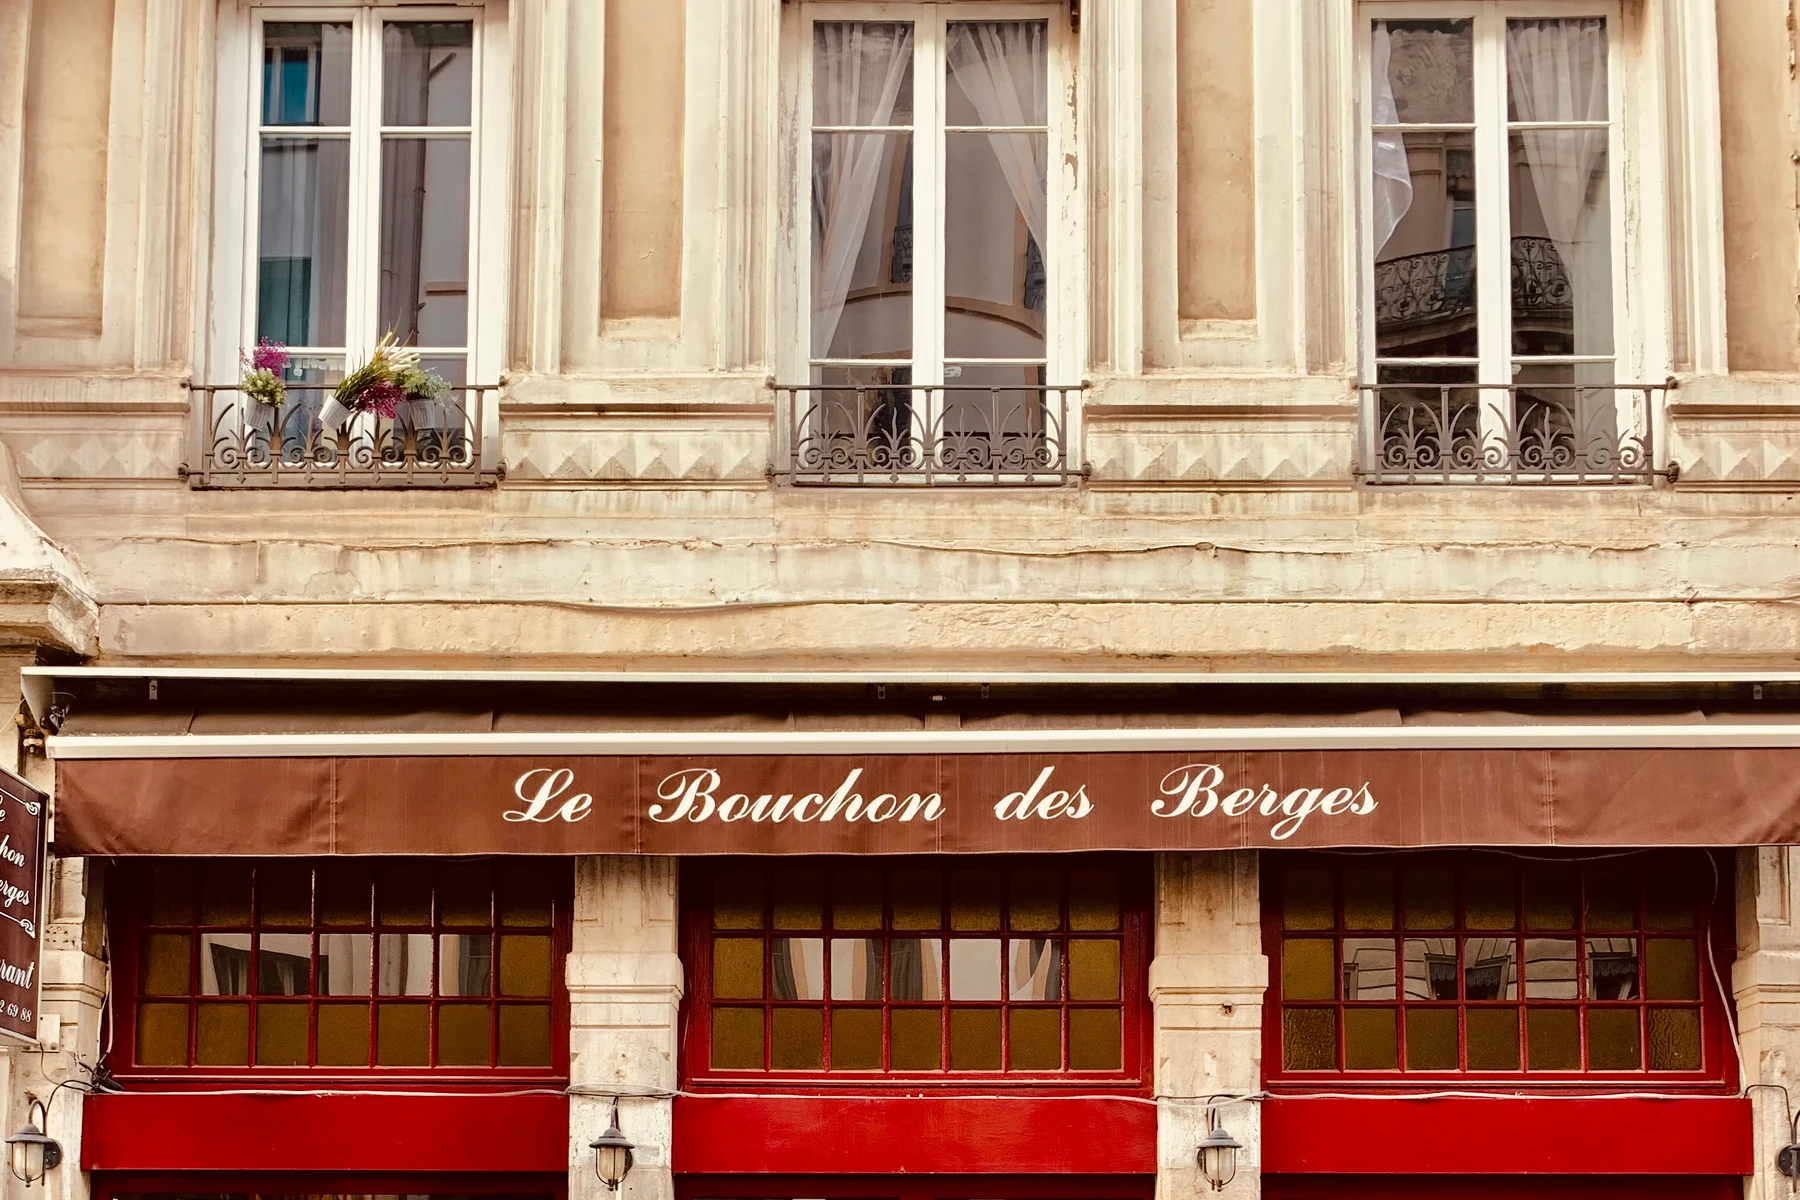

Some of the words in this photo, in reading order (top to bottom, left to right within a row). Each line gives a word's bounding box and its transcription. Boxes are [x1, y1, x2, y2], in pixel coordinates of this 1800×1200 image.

[503, 769, 592, 822] Le
[649, 769, 945, 822] Bouchon
[994, 767, 1094, 820] des
[1151, 764, 1378, 840] Berges
[8, 1003, 19, 1017] 69
[21, 1007, 32, 1023] 88
